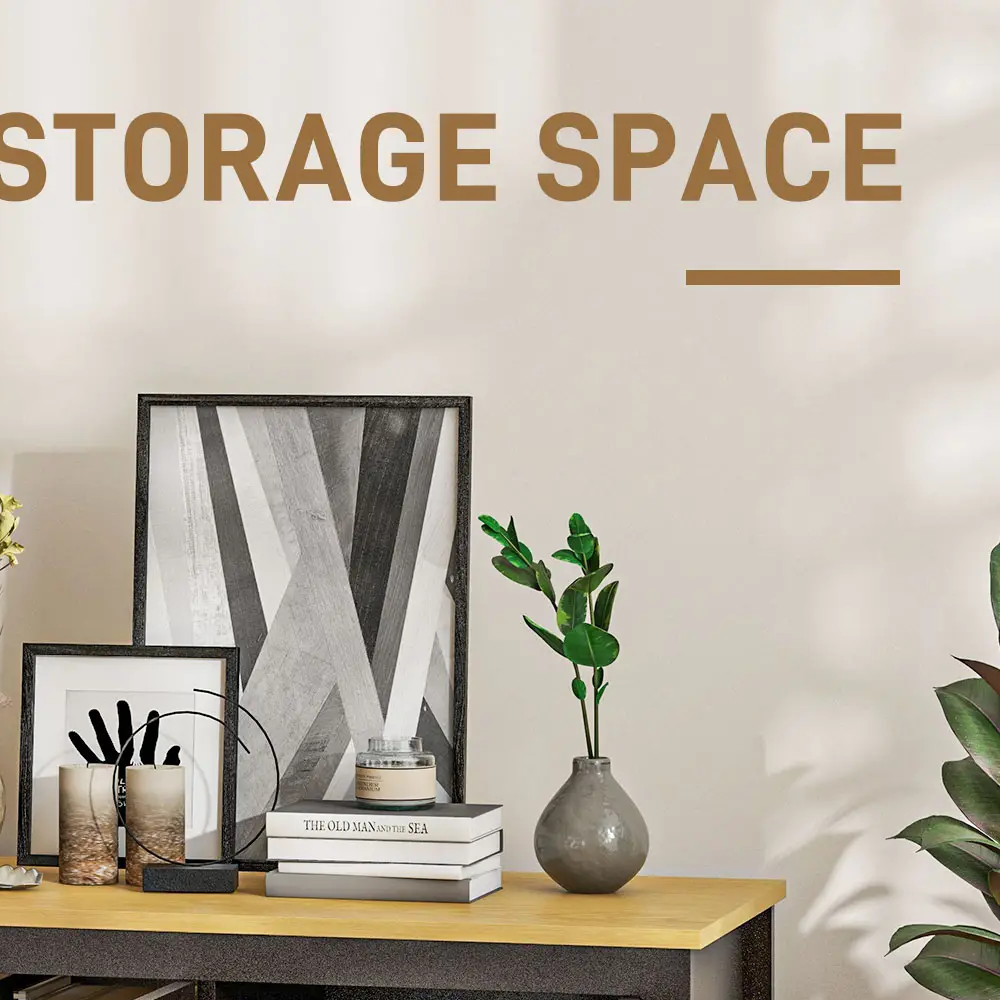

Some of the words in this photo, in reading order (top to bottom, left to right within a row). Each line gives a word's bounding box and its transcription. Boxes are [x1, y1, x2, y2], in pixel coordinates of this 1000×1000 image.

[303, 819, 326, 831] THE
[327, 820, 351, 832] OLD
[352, 821, 376, 833] MAN
[376, 825, 391, 833] AND
[392, 825, 406, 833] THE
[408, 822, 429, 834] SEA
